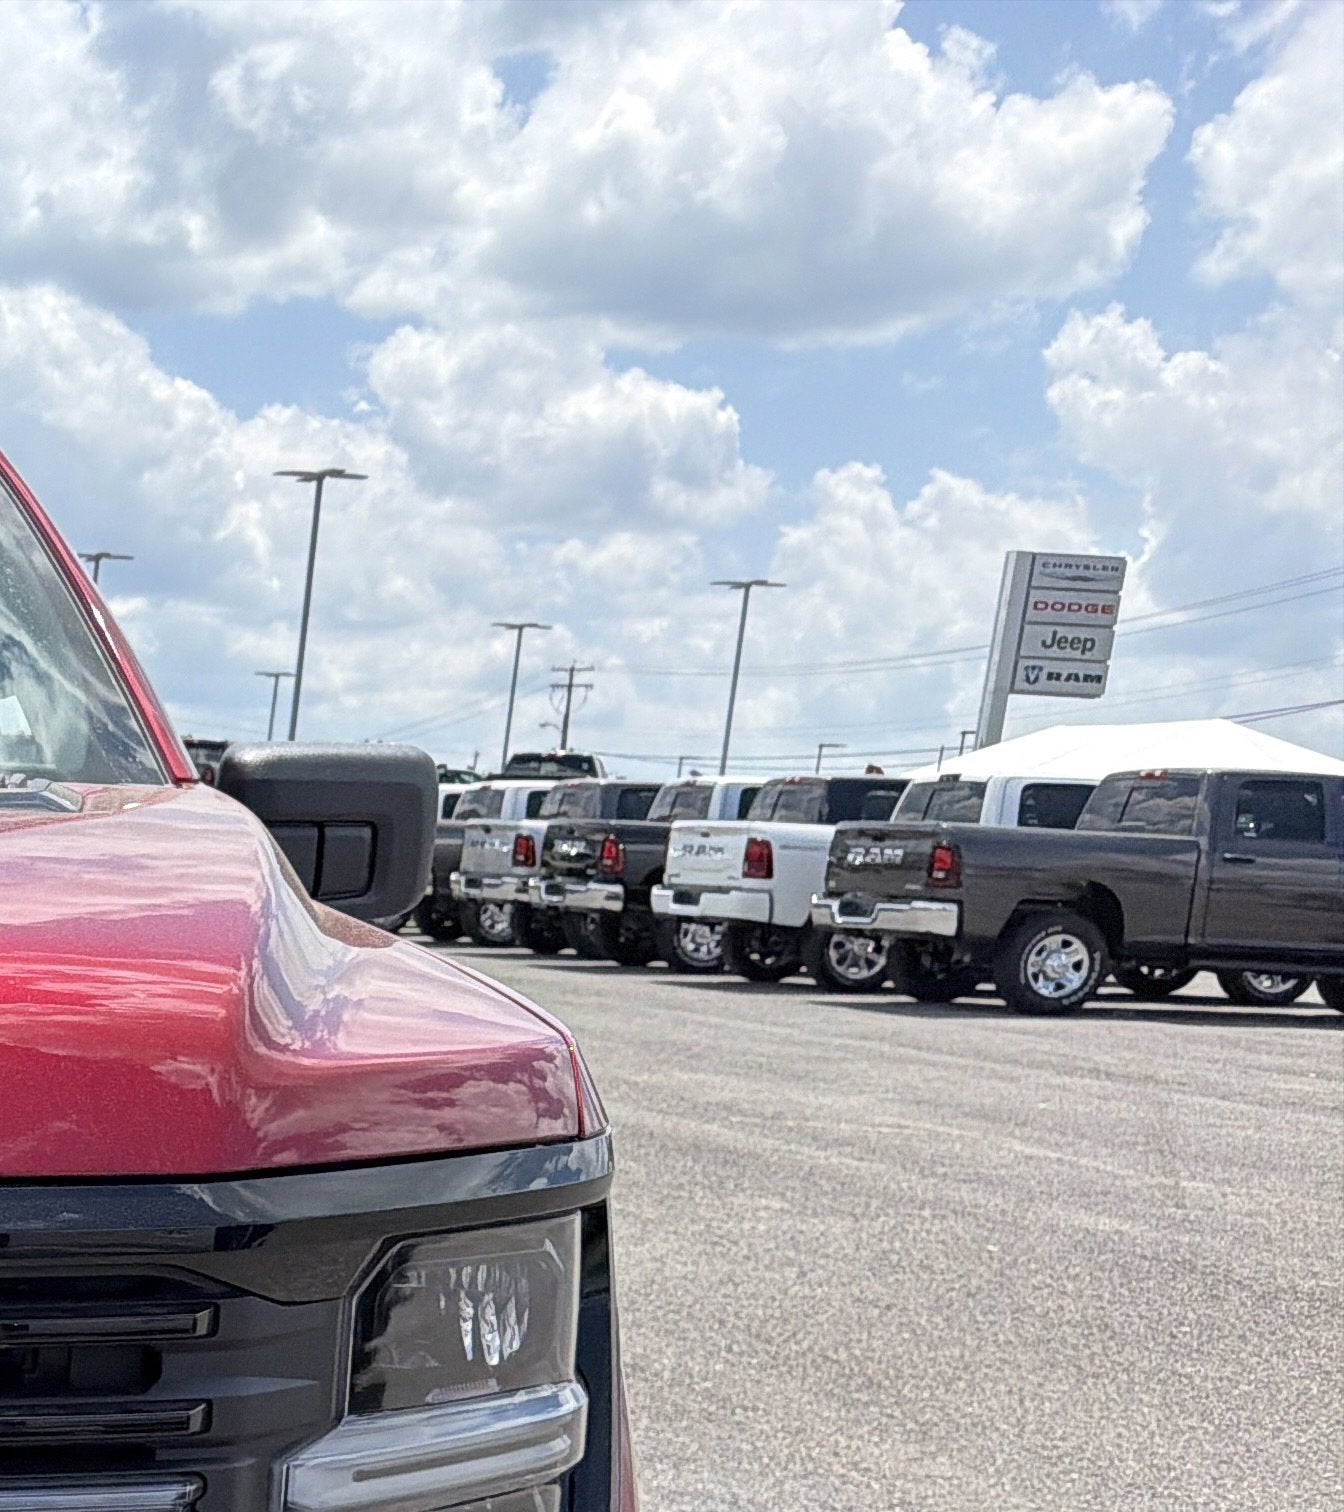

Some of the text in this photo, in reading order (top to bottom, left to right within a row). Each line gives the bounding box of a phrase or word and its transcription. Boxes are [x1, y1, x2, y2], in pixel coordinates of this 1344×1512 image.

[1041, 561, 1120, 573] CHRYSLER
[1032, 600, 1115, 615] DODGE
[1040, 629, 1097, 655] Jeep
[1046, 671, 1104, 685] RAM
[846, 847, 904, 866] RAM
